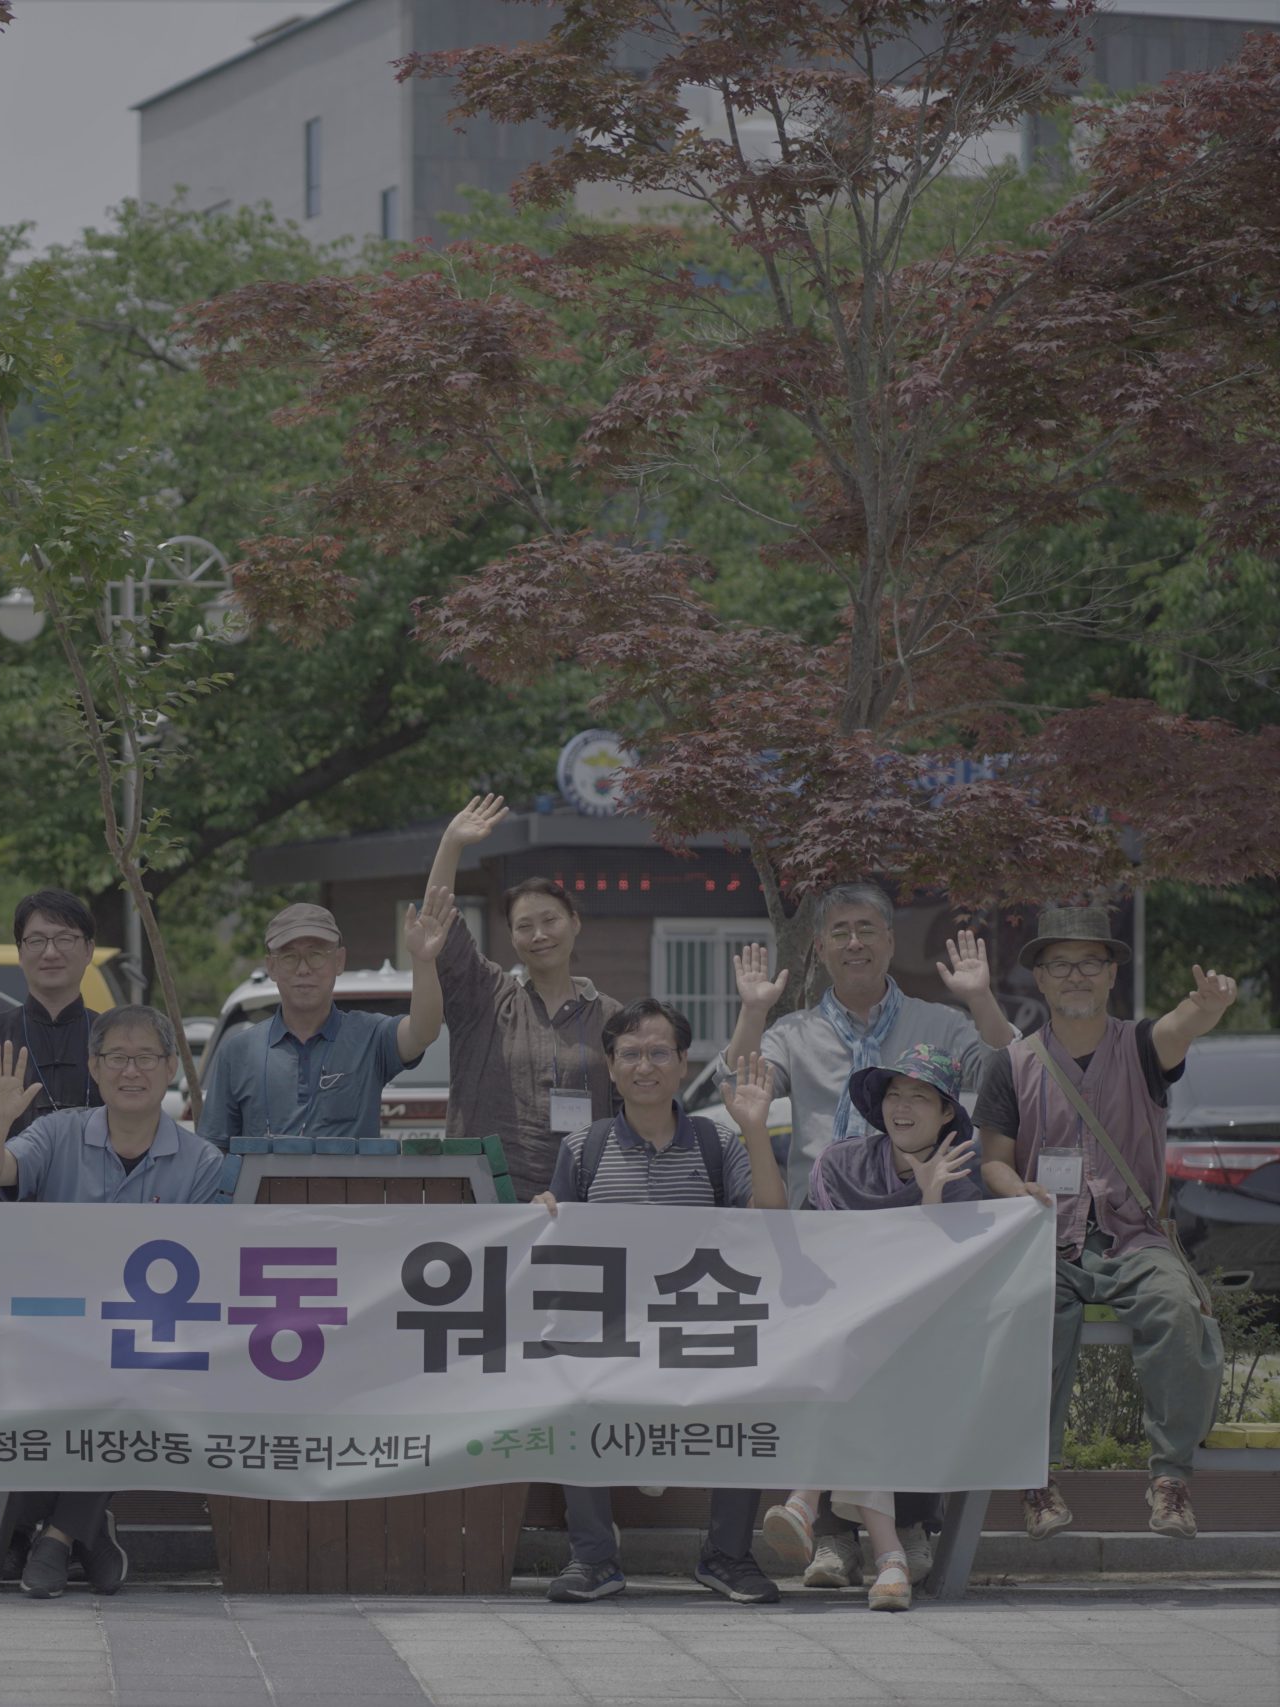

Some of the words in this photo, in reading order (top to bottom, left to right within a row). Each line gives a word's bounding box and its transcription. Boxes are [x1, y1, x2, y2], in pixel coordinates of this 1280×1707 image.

[396, 1241, 770, 1374] 워크숍
[65, 1428, 193, 1465] 내장상동
[204, 1433, 432, 1472] 공감플러스센터
[490, 1425, 556, 1459] 주최
[590, 1421, 781, 1460] (사)밝은마을
